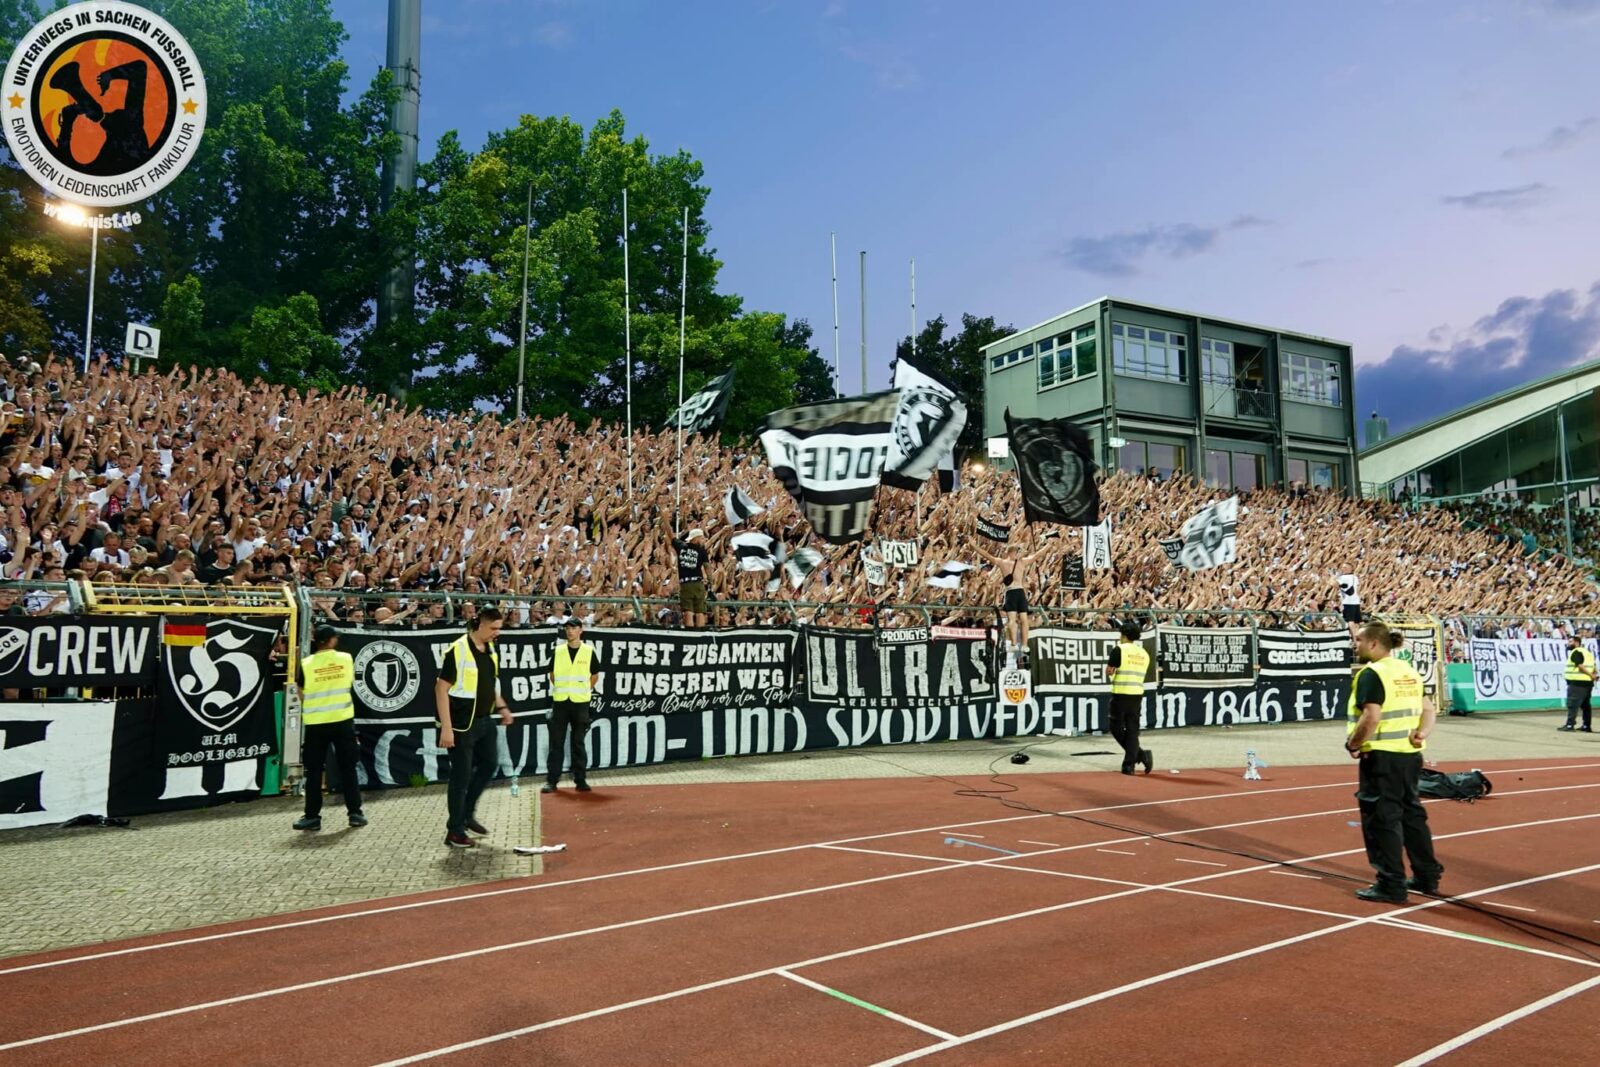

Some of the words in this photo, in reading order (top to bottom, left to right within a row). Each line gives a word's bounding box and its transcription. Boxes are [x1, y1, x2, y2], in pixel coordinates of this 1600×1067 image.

[133, 328, 153, 350] D
[881, 628, 928, 643] PRODIGYS
[28, 625, 150, 676] CREW
[611, 641, 674, 666] FEST
[682, 642, 786, 666] ZUSAMMEN
[1268, 649, 1344, 664] constante
[1474, 649, 1495, 660] SSV
[1499, 643, 1525, 663] SSV
[809, 636, 991, 697] ULTRAS
[1475, 659, 1497, 671] 1846
[615, 670, 730, 695] UNSEREN
[737, 668, 785, 690] WEG
[589, 696, 605, 714] ür
[610, 698, 655, 712] unsere
[661, 693, 709, 713] Brüder
[713, 694, 733, 705] vor
[735, 689, 757, 706] den
[838, 697, 898, 707] BROKEN
[908, 695, 969, 707] SOCIETY
[1203, 687, 1283, 726] 1846
[201, 733, 238, 746] ULM
[167, 743, 271, 766] HOOLIGANS
